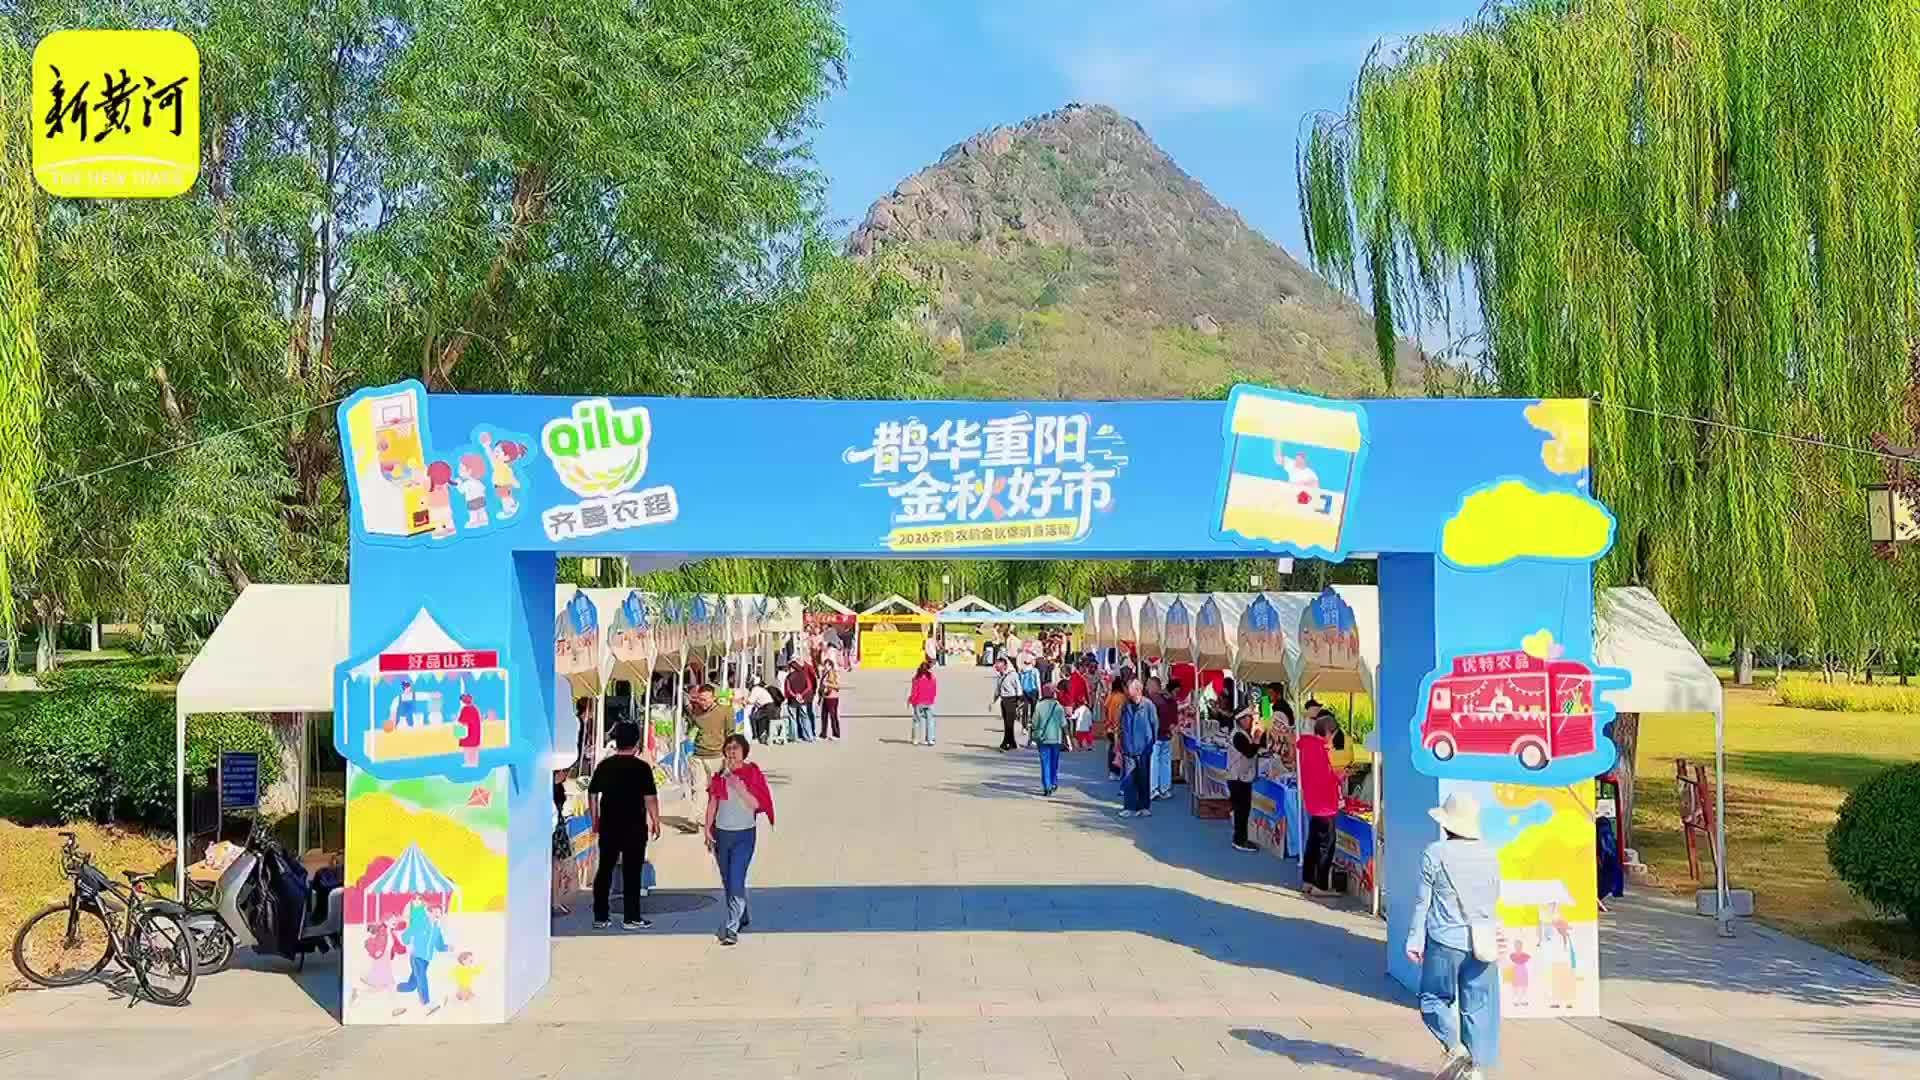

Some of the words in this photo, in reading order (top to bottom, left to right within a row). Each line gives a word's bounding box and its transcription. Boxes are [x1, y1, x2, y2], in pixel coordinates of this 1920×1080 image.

[850, 412, 1089, 473] 鹊华重阳
[549, 492, 672, 536] 齐鲁农超
[888, 463, 1117, 535] 金秋好市
[408, 653, 476, 670] 好品山东
[1462, 655, 1530, 673] 优特农品
